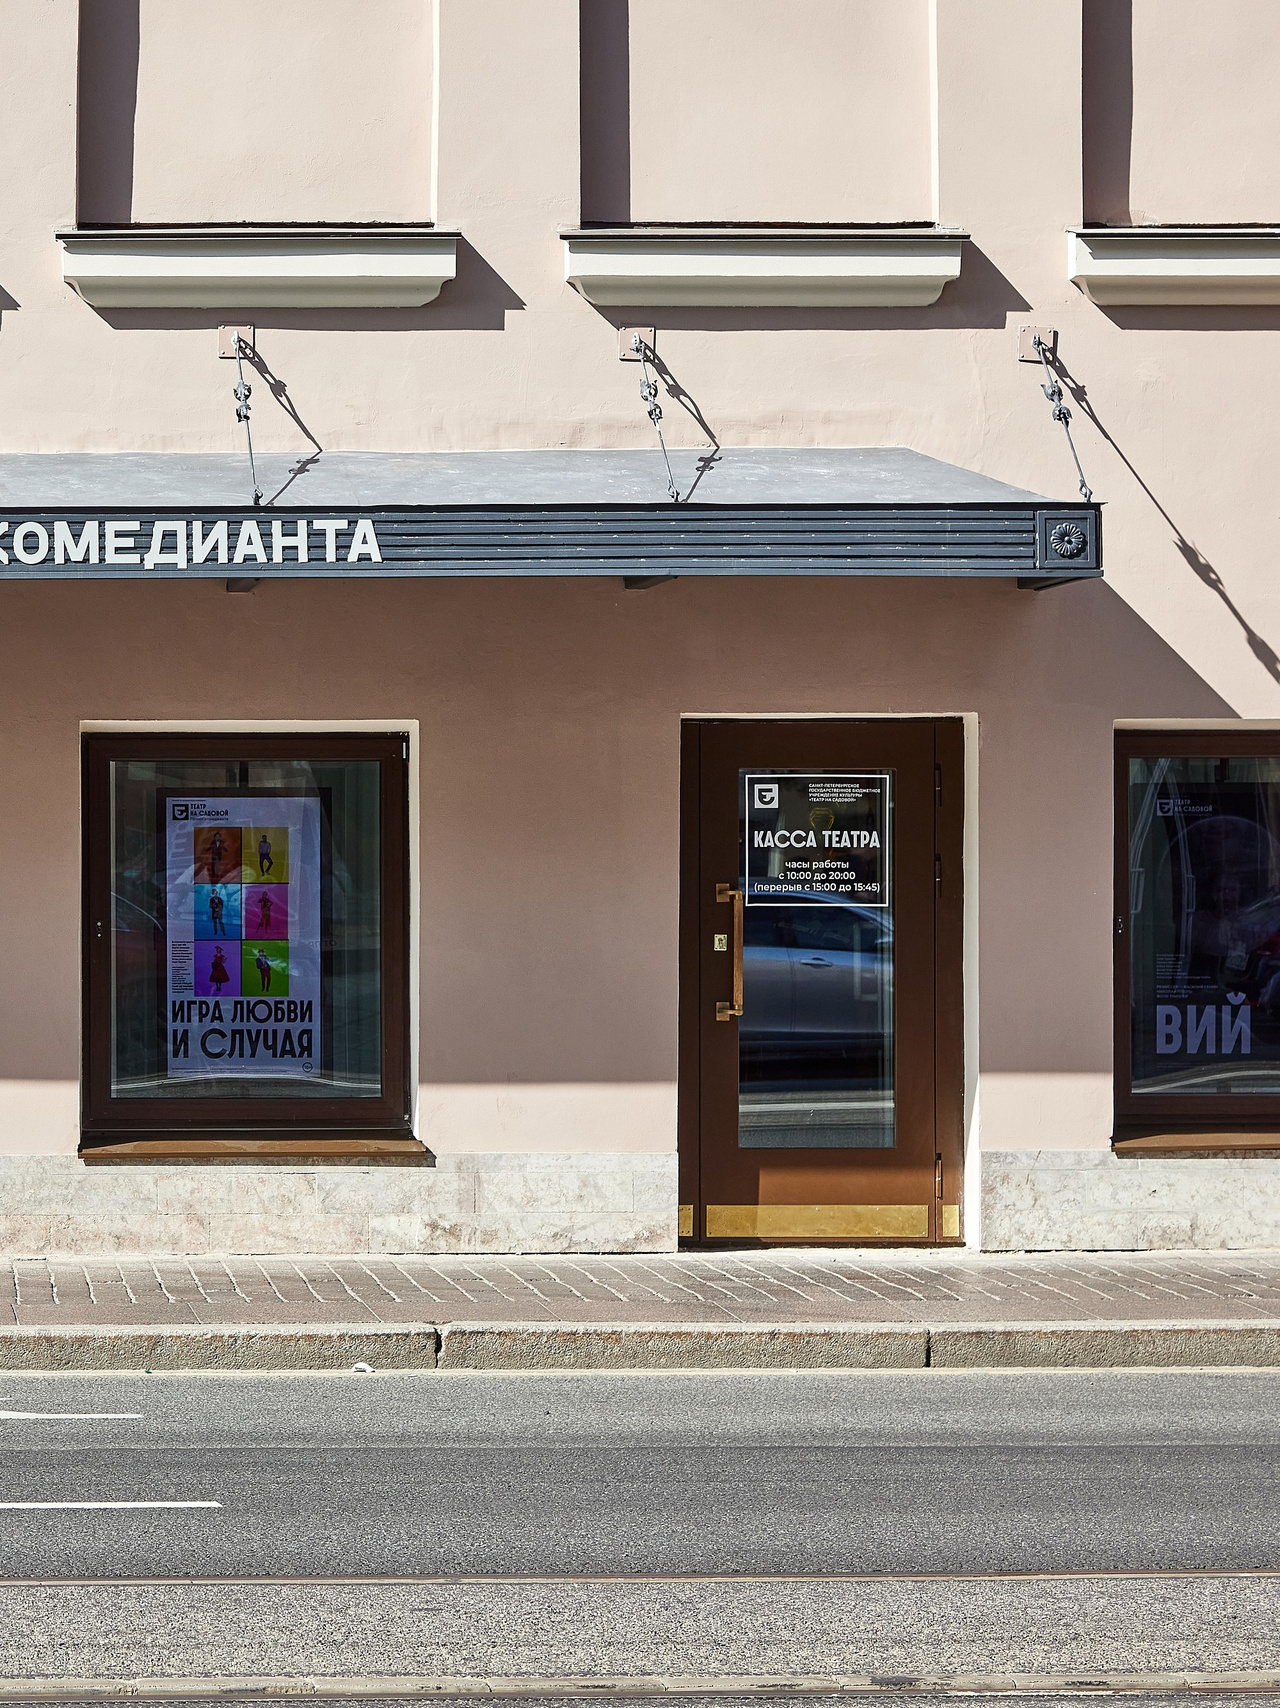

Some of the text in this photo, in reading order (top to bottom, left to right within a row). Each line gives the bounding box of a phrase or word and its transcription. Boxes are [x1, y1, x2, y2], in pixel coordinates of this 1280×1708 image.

[754, 830, 880, 848] КАССА ТЕАТРА
[785, 860, 849, 871] часы работы
[787, 872, 812, 880] 10:00
[814, 873, 827, 881] до
[829, 872, 856, 880] 20:00
[754, 883, 802, 893] (перерыв
[812, 883, 837, 892] 15:00
[839, 885, 852, 893] до
[854, 883, 880, 894] 15:45)
[172, 1000, 313, 1023] ИГРА ЛЮБВИ
[1156, 991, 1251, 1054] ВИЙ
[172, 1028, 313, 1059] И СЛУЧАЯ
